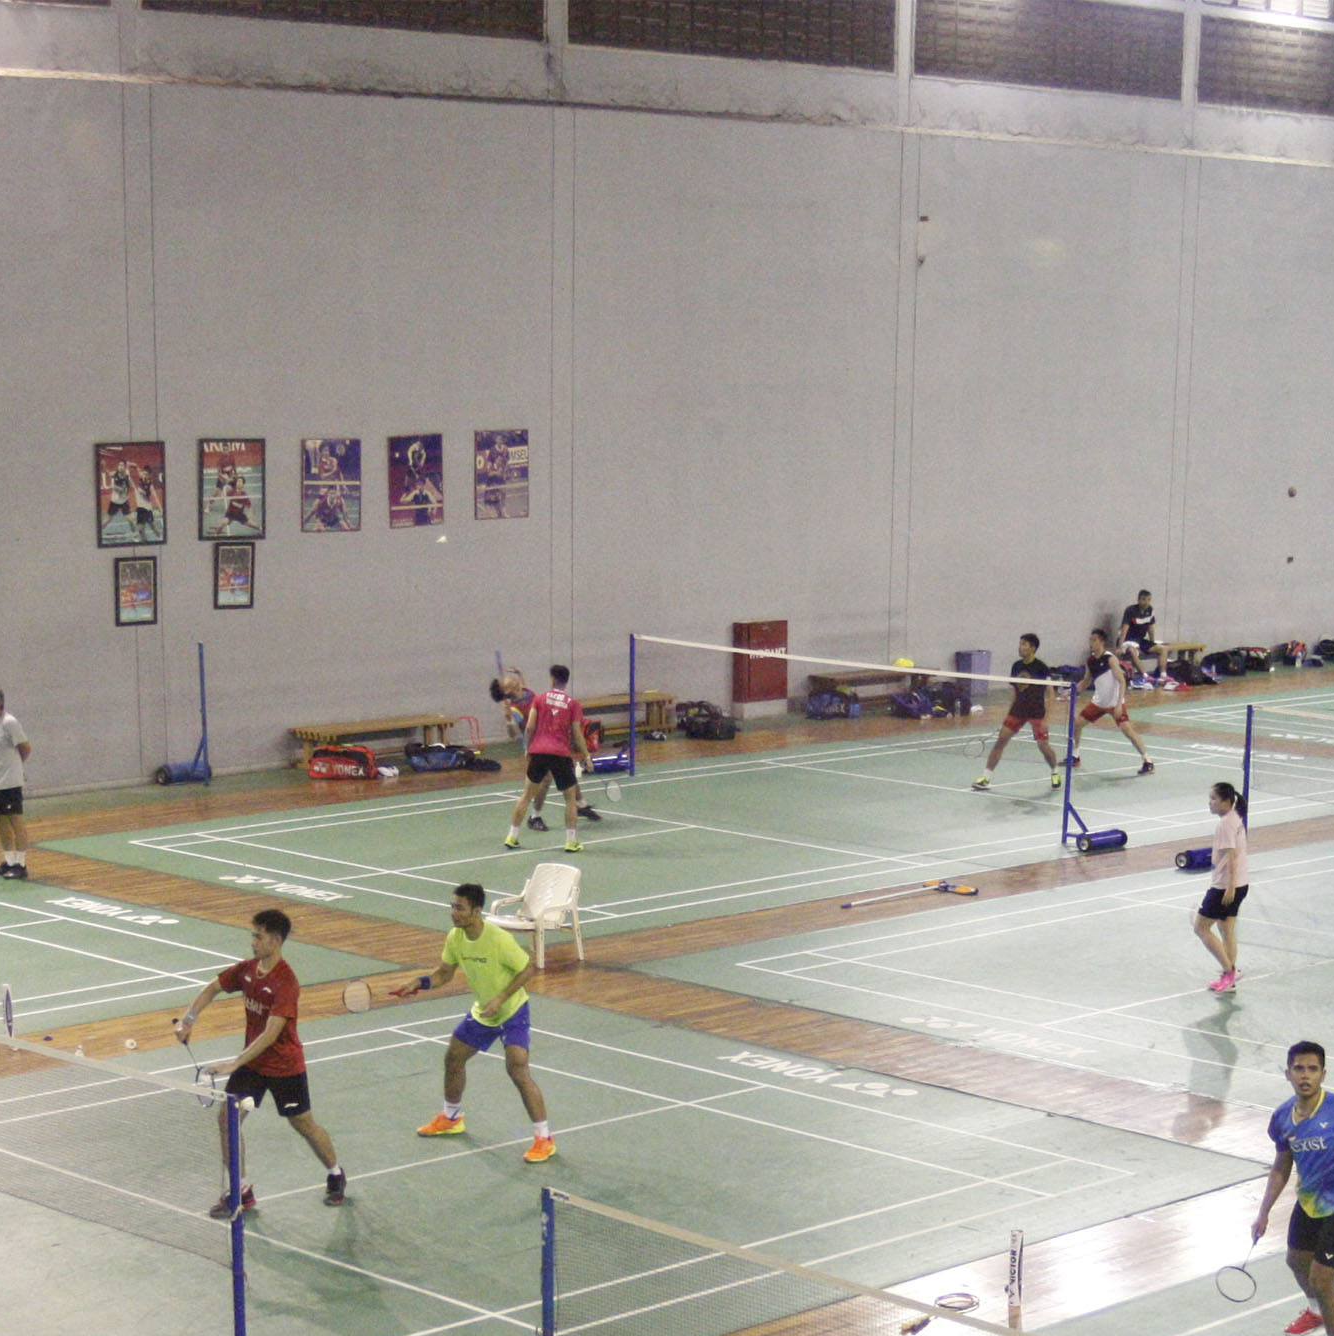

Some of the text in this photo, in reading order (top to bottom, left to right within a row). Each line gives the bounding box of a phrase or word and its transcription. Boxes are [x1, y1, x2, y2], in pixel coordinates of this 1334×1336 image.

[333, 764, 365, 777] YONEX
[717, 1051, 843, 1085] YONEX
[1009, 1249, 1018, 1286] VICTOR
